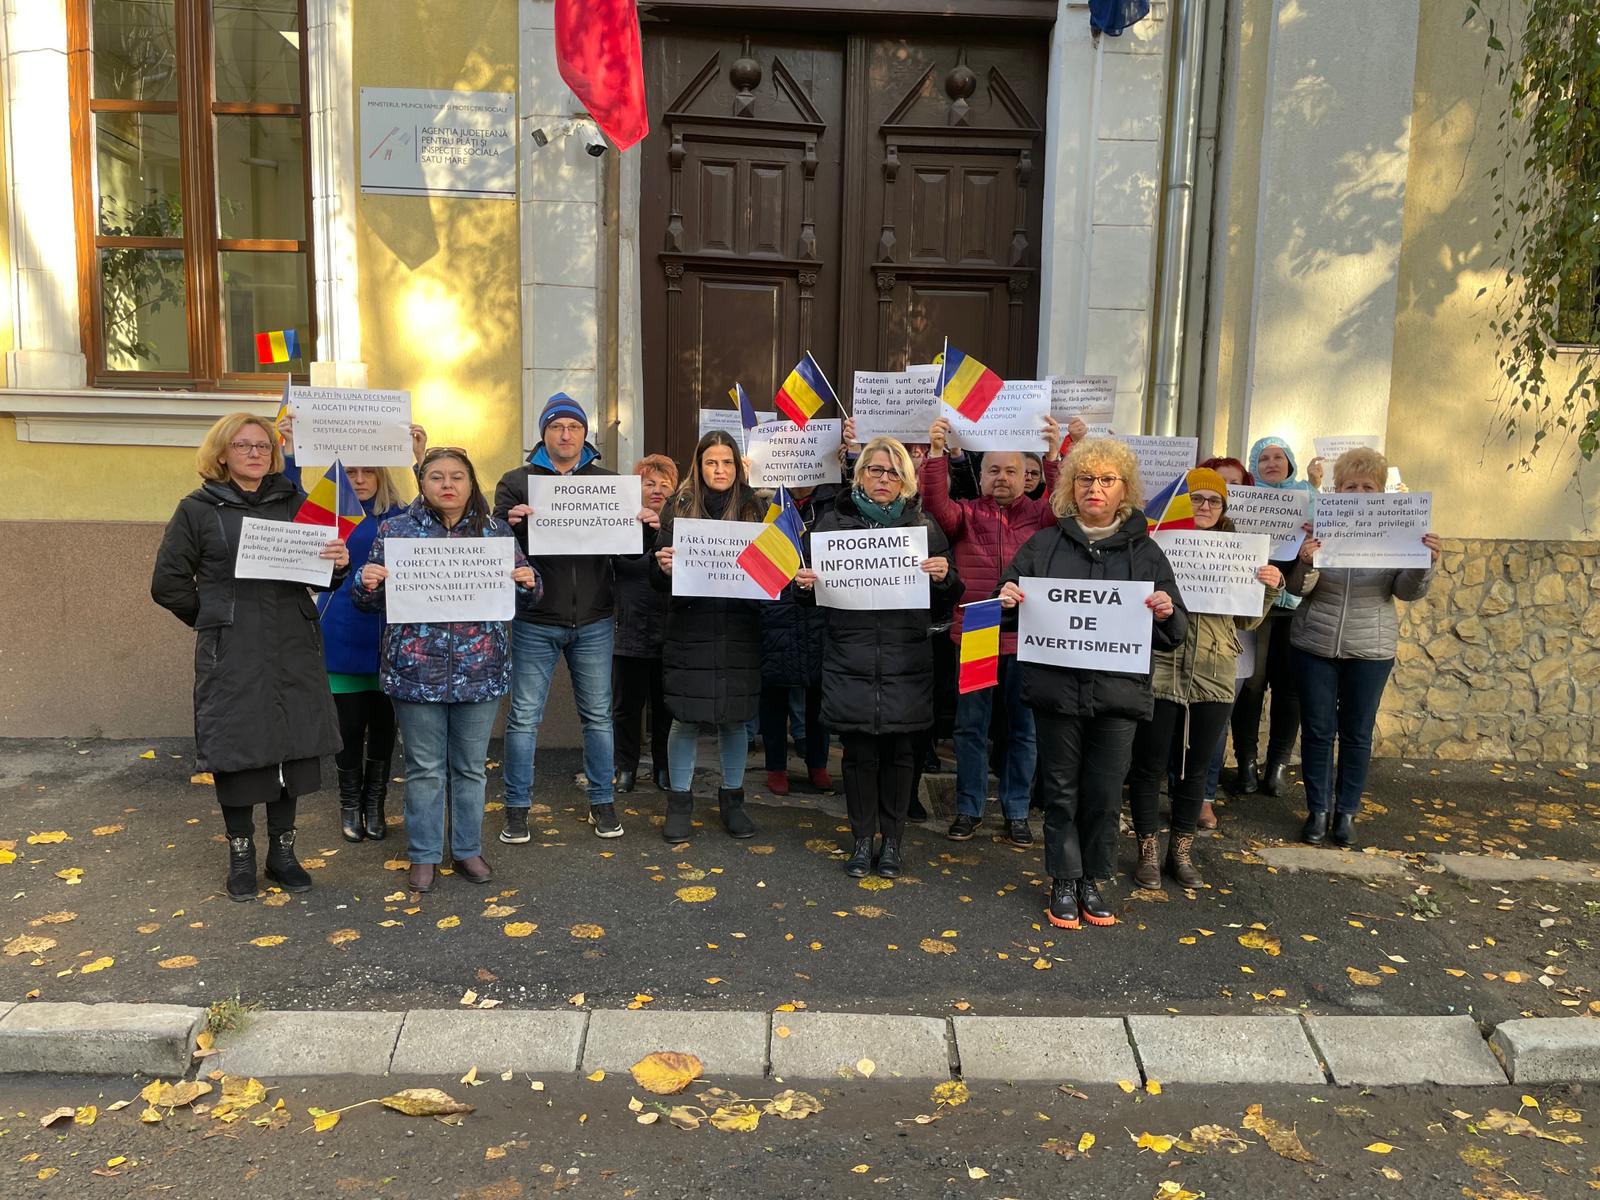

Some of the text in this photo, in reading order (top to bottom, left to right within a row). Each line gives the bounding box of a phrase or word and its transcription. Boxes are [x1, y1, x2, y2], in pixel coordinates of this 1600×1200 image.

[422, 136, 454, 144] PENTRU
[422, 156, 468, 164] SATU MARE
[758, 425, 787, 434] RESURSE
[798, 472, 826, 481] OPTIME
[554, 486, 616, 494] PROGRAME
[551, 502, 620, 511] INFORMATICE
[1393, 498, 1412, 506] egali
[1260, 507, 1302, 516] PERSONAL
[536, 517, 634, 526] CORESPUNZĂTOARE
[1260, 520, 1293, 528] PENTRU
[1316, 520, 1348, 528] publice,
[1379, 520, 1415, 528] privilegii
[680, 536, 753, 546] FĂRĂ DISCRIMI
[828, 536, 910, 551] PROGRAME
[1175, 538, 1243, 549] REMUNERARE
[243, 543, 270, 552] publice,
[288, 548, 318, 557] privilegii
[1164, 549, 1203, 558] ORECTA
[1218, 552, 1257, 562] RAPORT
[685, 560, 743, 570] FUNCȚIONA
[821, 556, 919, 572] INFORMATICE
[1209, 564, 1245, 572] DEPUSA
[708, 573, 745, 581] PUBLICI
[1173, 573, 1256, 584] ONSABILITATILE
[825, 575, 916, 589] FUNCȚIONALE !!!
[395, 582, 505, 592] RESPONSABILITATILE
[1181, 585, 1226, 594] ASUMATE
[427, 594, 476, 602] ASUMATE
[1048, 588, 1122, 605] GREVĂ
[1069, 616, 1097, 631] DE
[1024, 635, 1142, 654] AVERTISMENT
